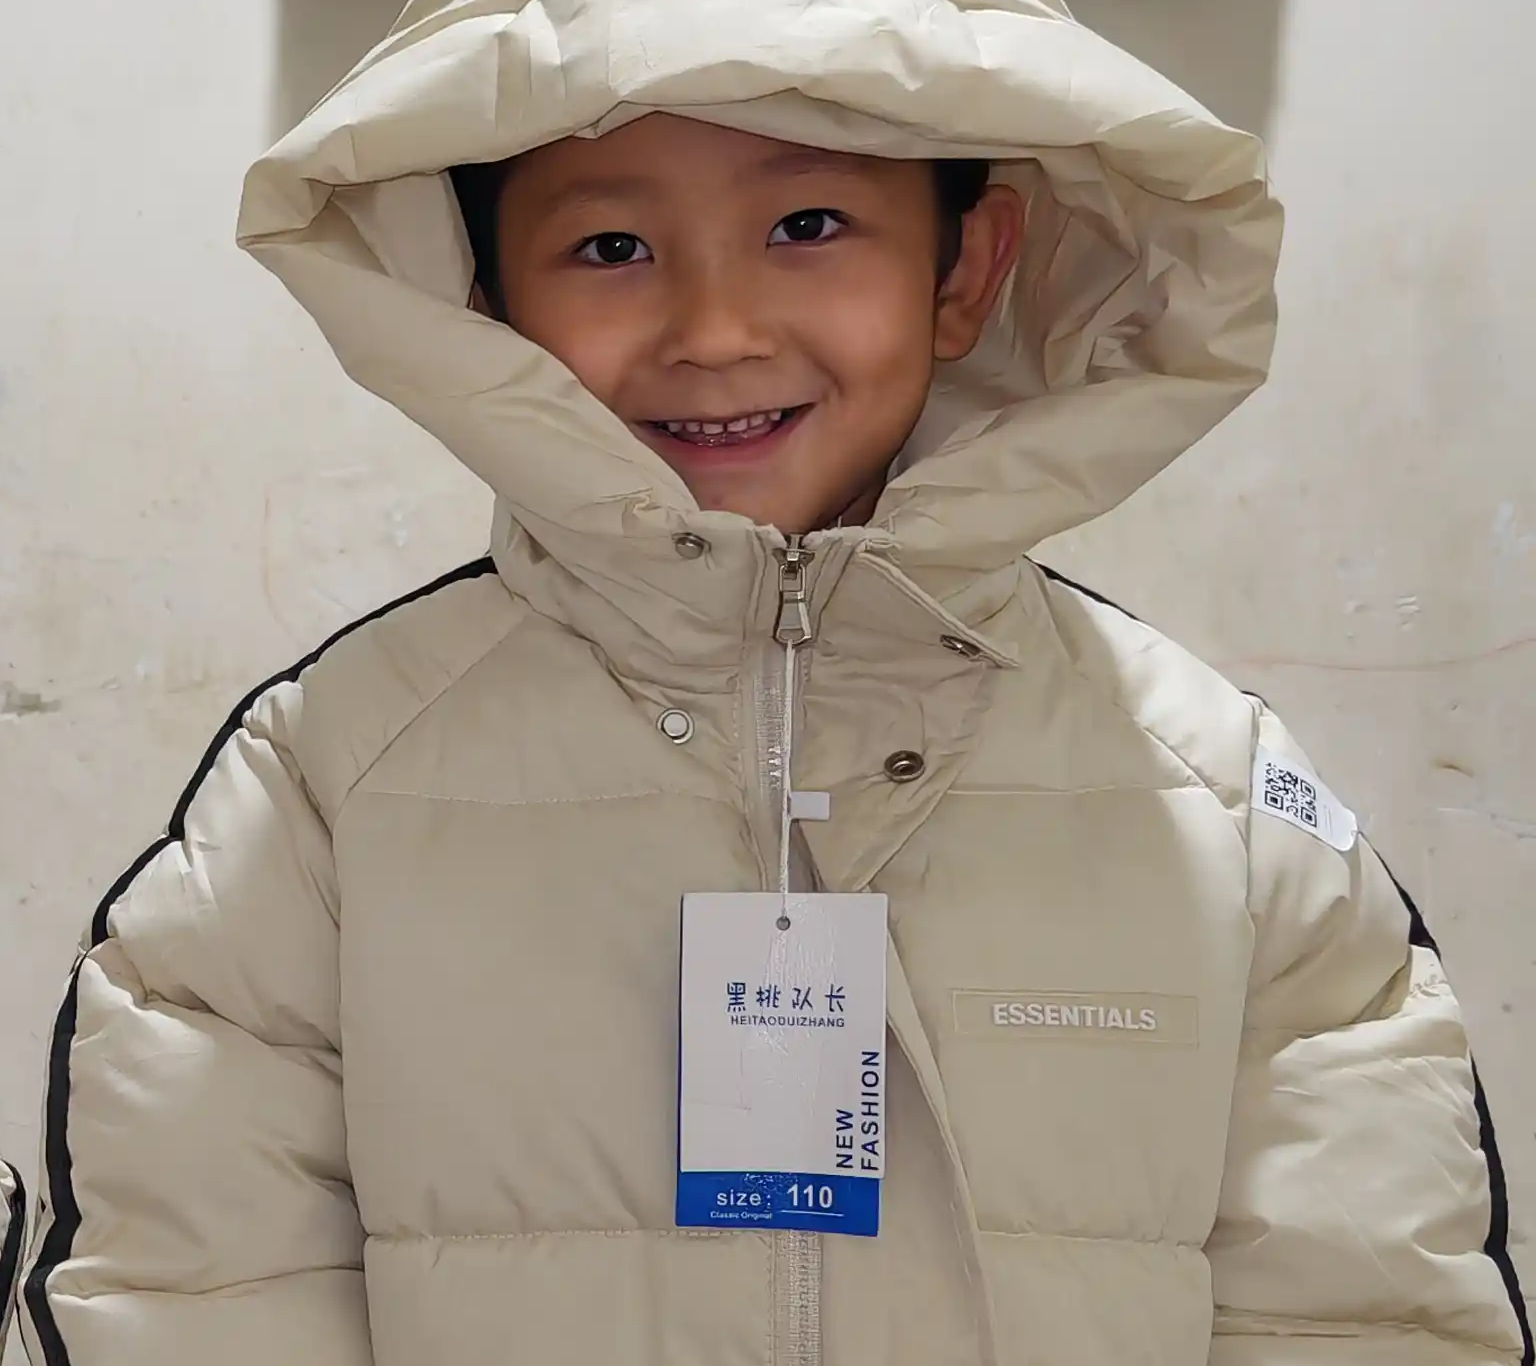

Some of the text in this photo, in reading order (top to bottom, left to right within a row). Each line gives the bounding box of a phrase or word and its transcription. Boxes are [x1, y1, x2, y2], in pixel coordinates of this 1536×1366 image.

[992, 1002, 1157, 1031] ESSENTIALS
[860, 1050, 881, 1172] FASHION
[835, 1108, 854, 1170] NEW
[786, 1183, 834, 1209] 110
